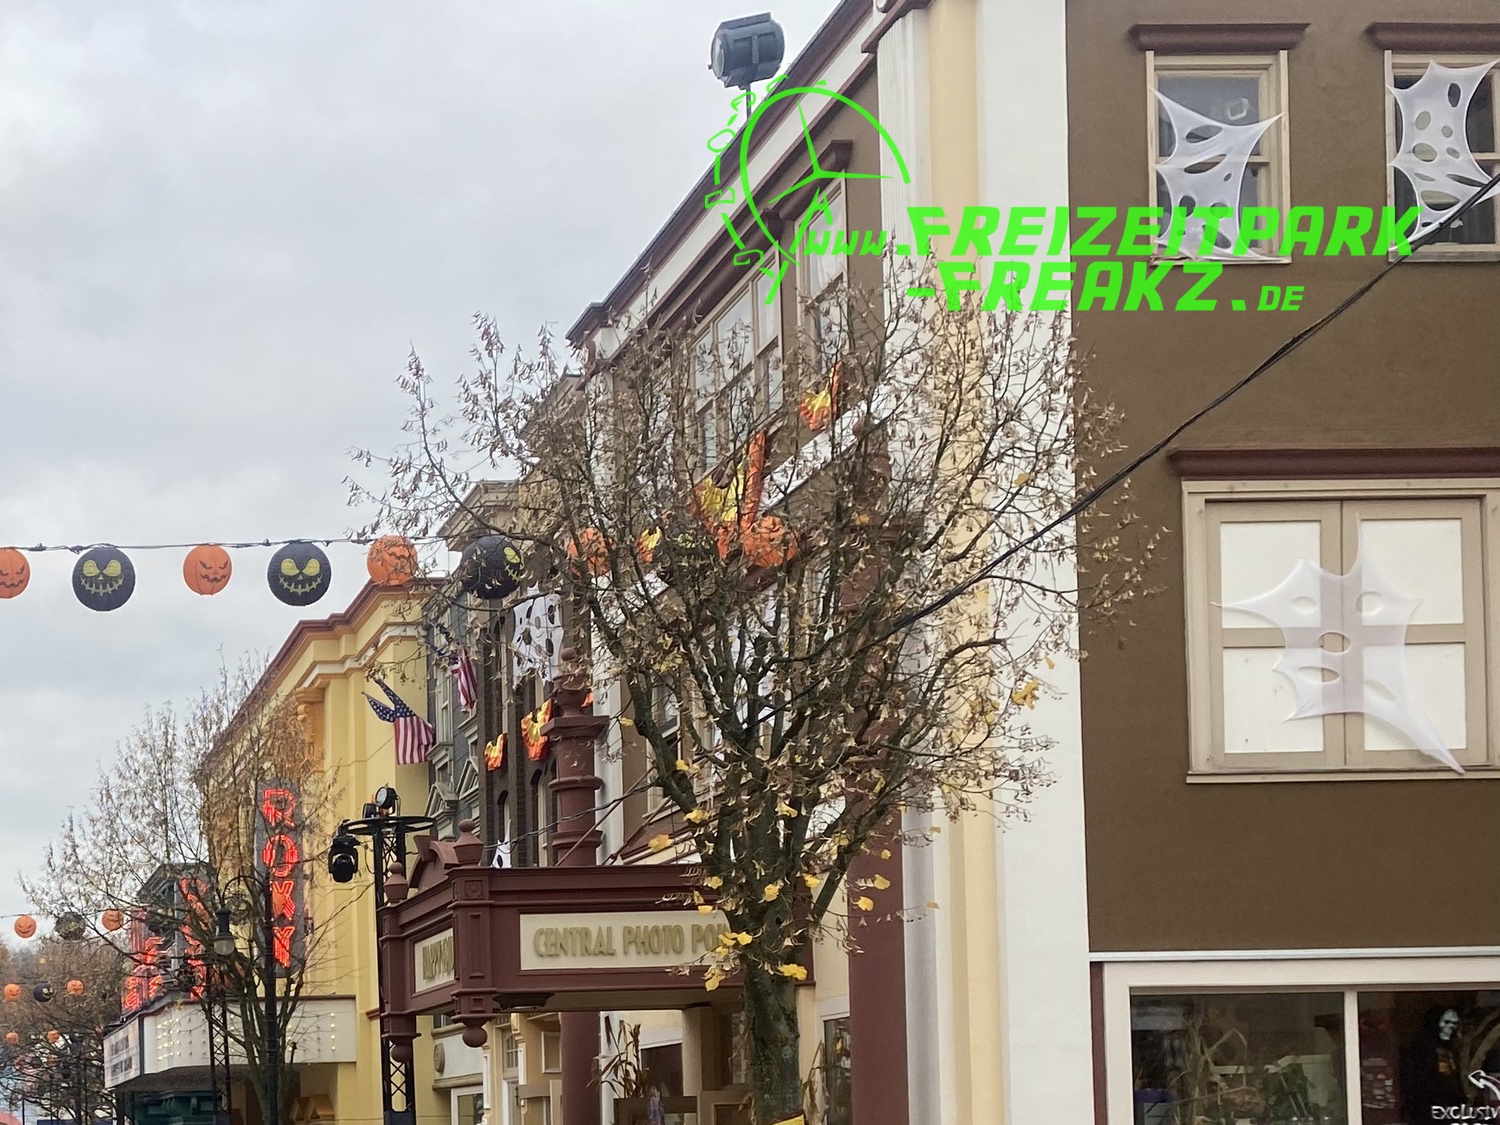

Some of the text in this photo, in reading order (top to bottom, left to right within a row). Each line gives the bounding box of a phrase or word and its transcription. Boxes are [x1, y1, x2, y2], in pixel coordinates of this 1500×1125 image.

[261, 788, 300, 969] ROXY
[533, 926, 616, 957] CENTRAL
[622, 924, 685, 956] PHOTO
